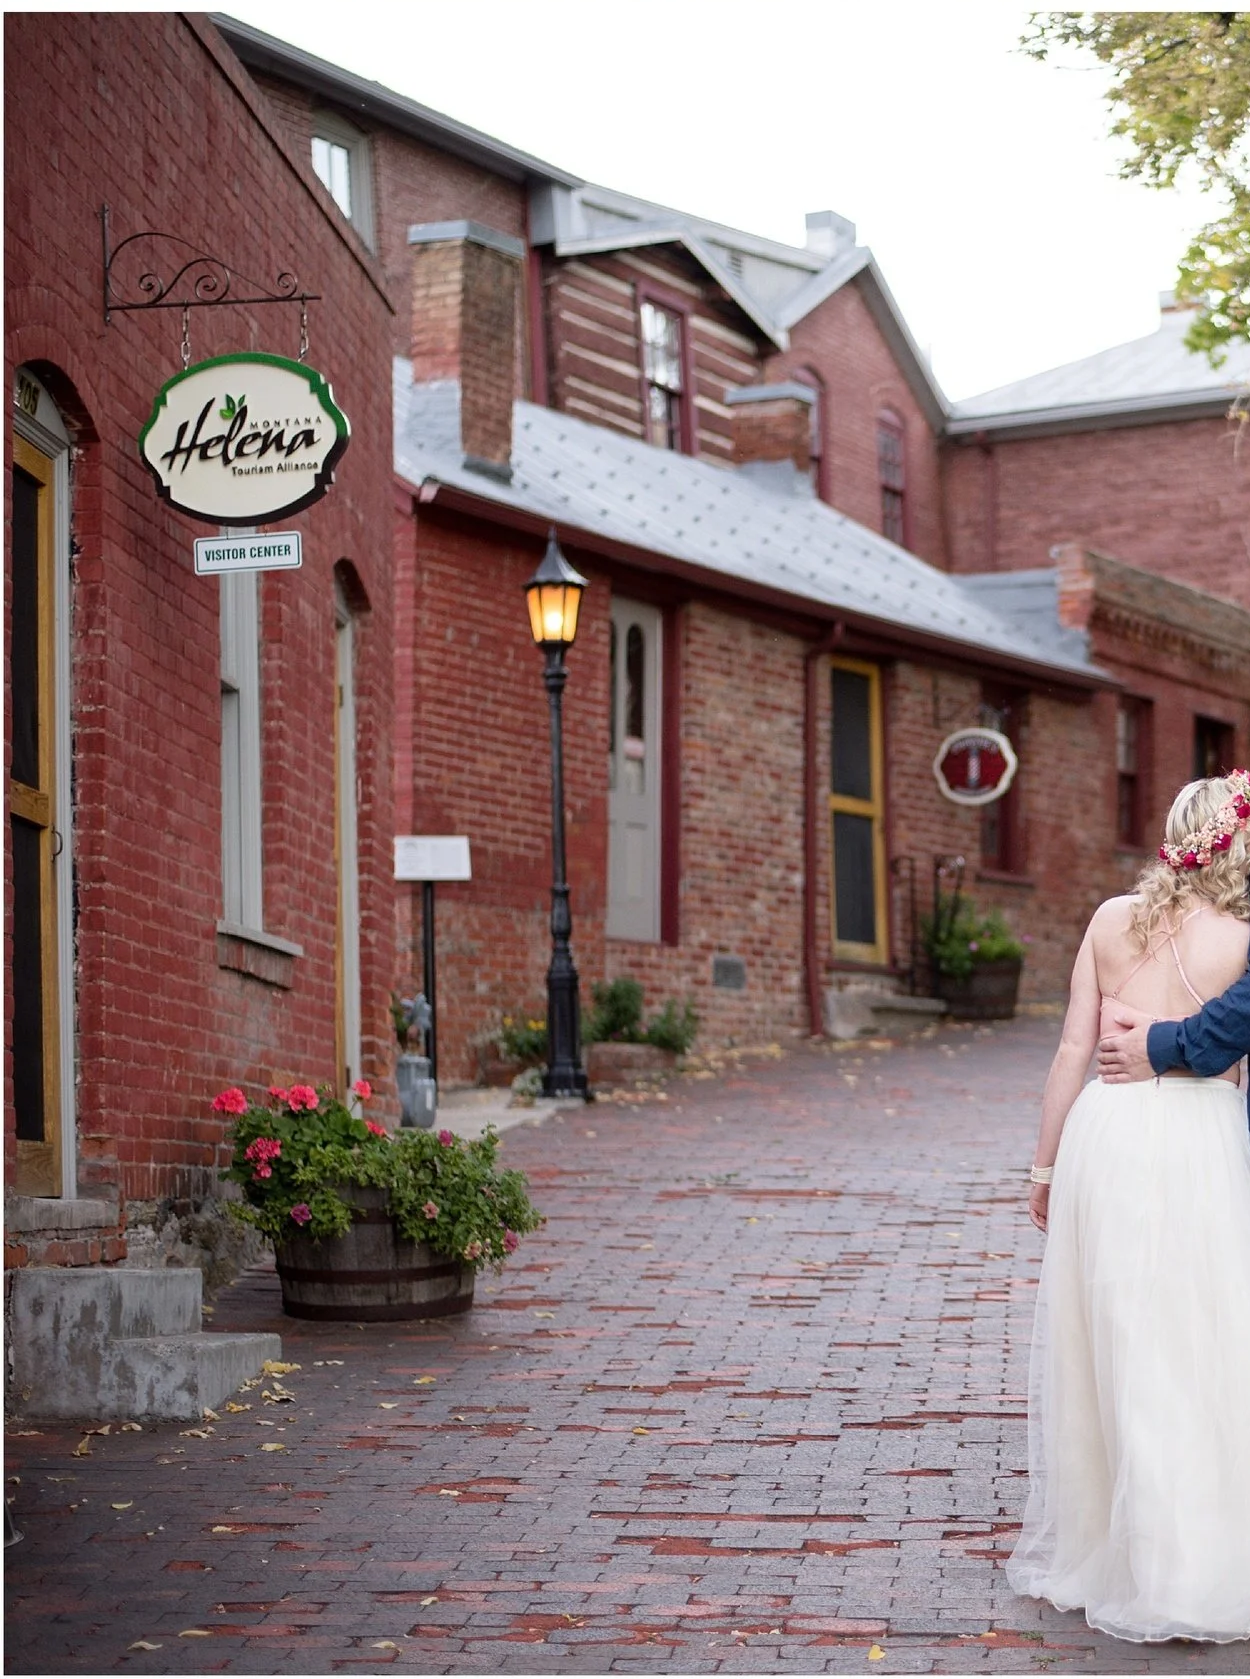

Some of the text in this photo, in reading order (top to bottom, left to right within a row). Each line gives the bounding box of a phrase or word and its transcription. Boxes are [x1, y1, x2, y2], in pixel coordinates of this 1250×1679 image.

[249, 416, 322, 429] MONTANA
[161, 397, 321, 473] Helena
[232, 461, 319, 477] Tourism Alliance
[204, 544, 291, 561] VISITOR CENTER
